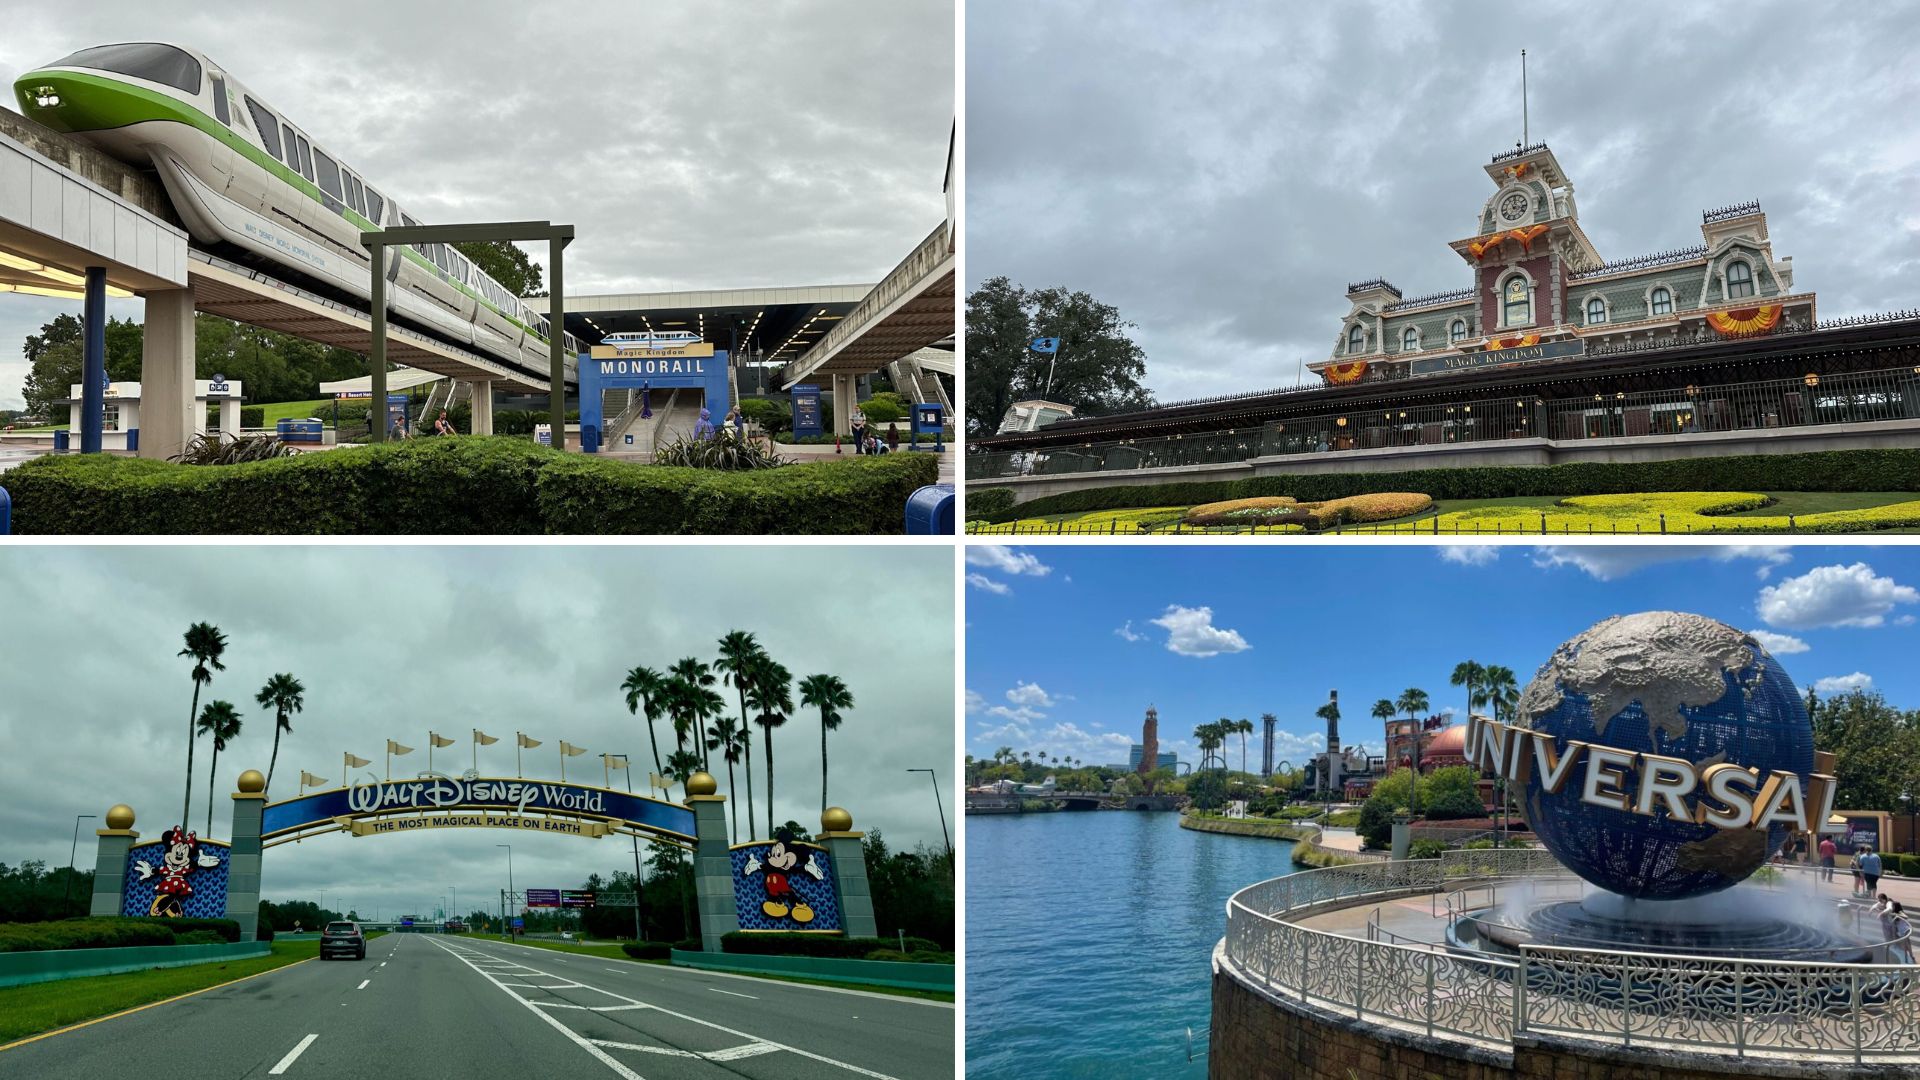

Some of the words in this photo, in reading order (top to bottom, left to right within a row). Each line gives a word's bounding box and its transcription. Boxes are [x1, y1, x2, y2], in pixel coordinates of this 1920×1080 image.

[646, 349, 685, 357] Kingdom
[1445, 356, 1481, 368] MAGIC
[1486, 347, 1544, 363] KINGDOM
[601, 361, 704, 374] MONORAIL
[1463, 713, 1849, 833] UNIVERSAL
[373, 822, 394, 833] THE
[399, 818, 428, 830] MOST
[432, 816, 482, 828] MAGICAL
[487, 817, 519, 828] PLACE
[523, 819, 540, 829] ON
[545, 821, 581, 834] EARTH
